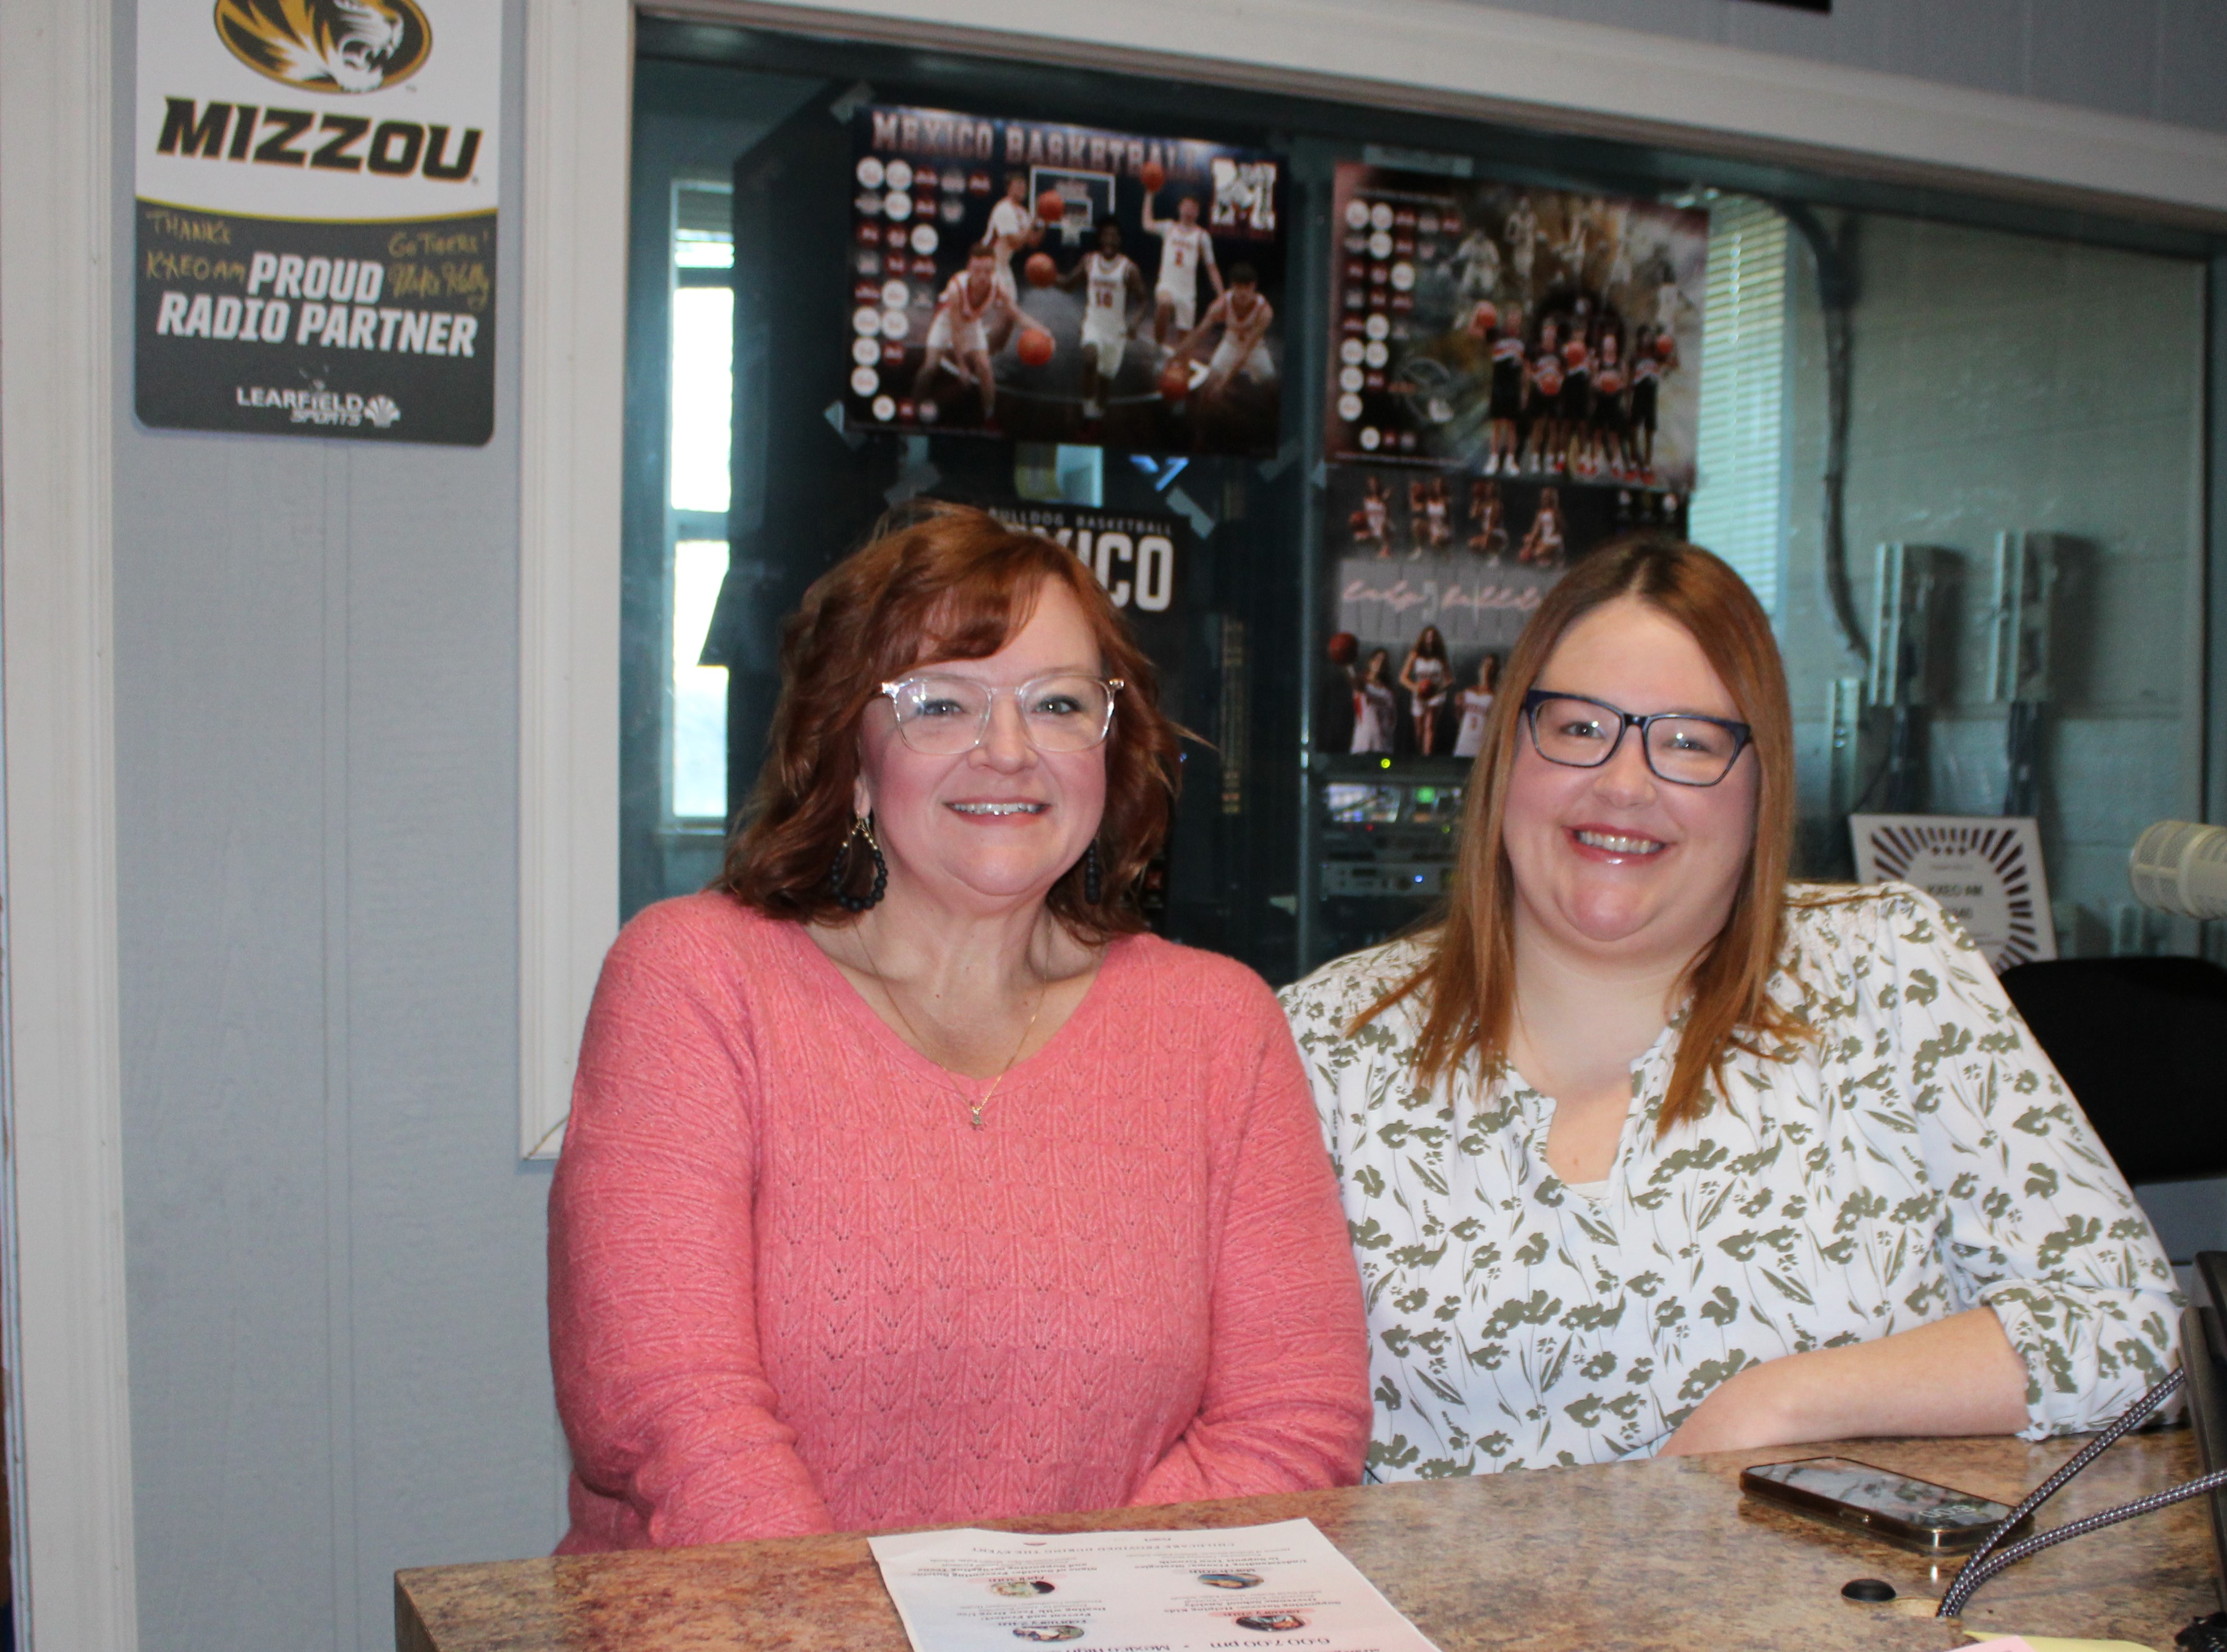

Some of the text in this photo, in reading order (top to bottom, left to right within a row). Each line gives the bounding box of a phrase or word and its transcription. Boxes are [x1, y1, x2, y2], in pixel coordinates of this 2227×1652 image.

[156, 96, 483, 183] MIZZOU
[872, 111, 1201, 182] MEXICO BASKETBALL
[145, 210, 231, 244] THANKS
[247, 251, 385, 305] PROUD
[156, 291, 478, 358] RADIO PARTNER
[236, 386, 363, 412] LEARFIELD
[987, 507, 1172, 535] BULLDOG BASKETBALL
